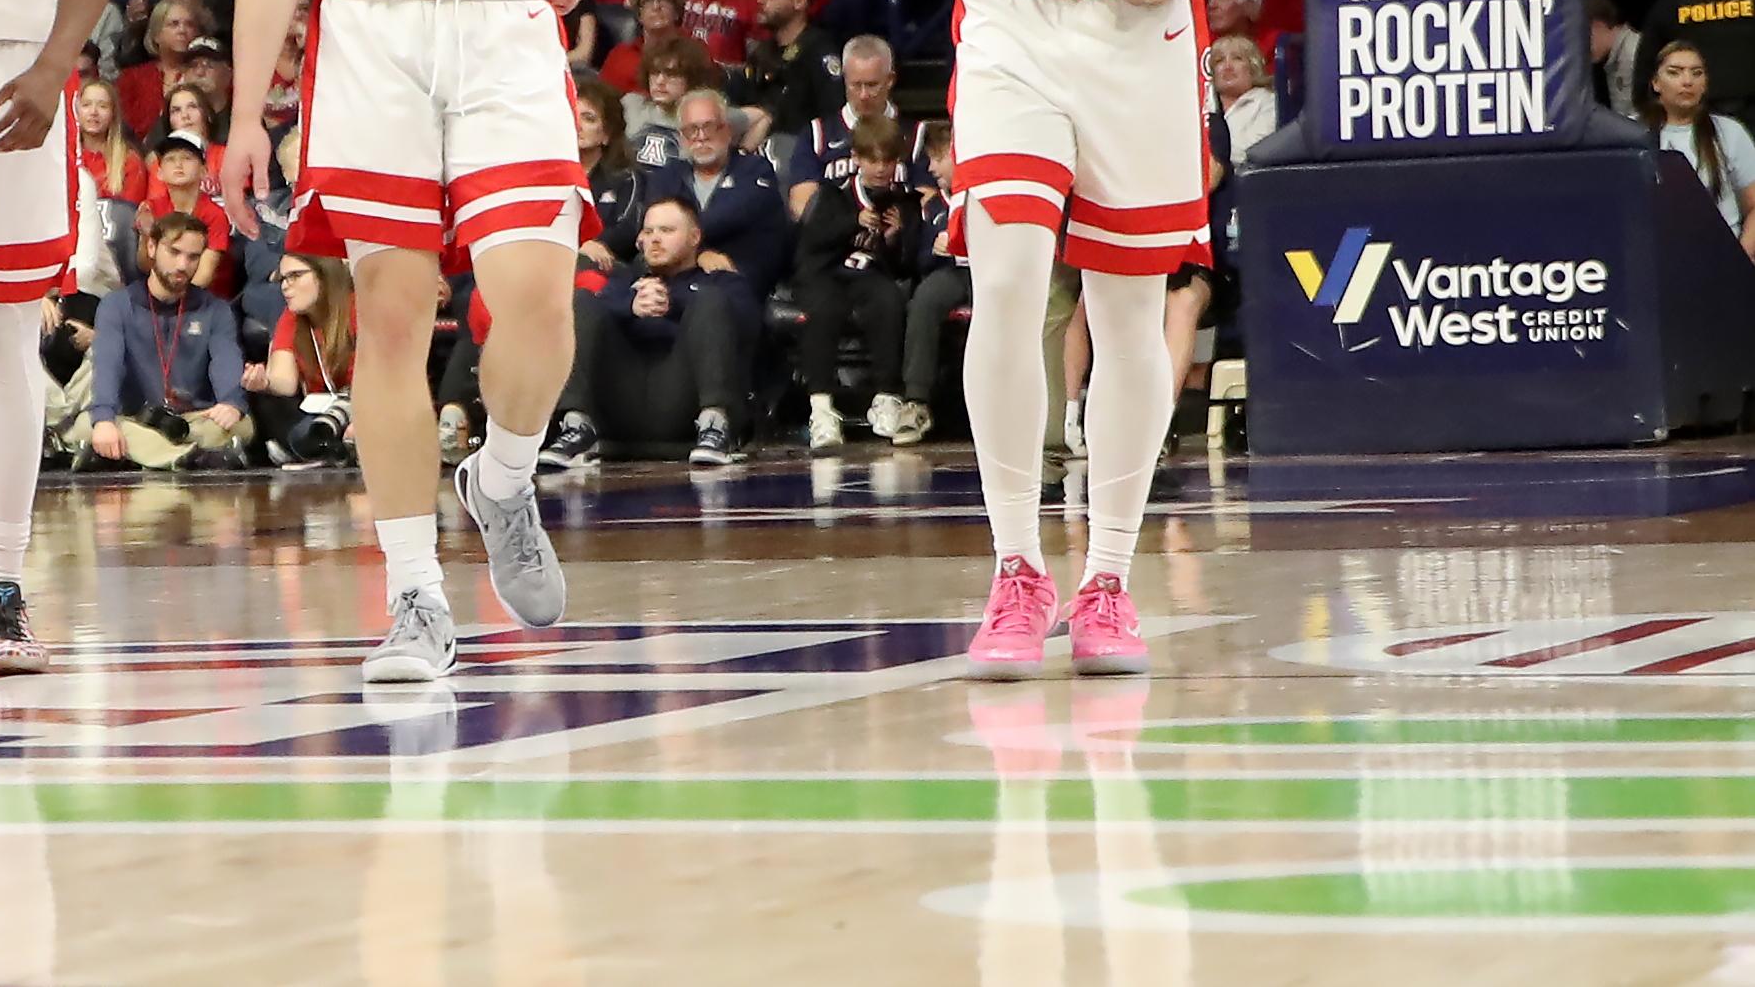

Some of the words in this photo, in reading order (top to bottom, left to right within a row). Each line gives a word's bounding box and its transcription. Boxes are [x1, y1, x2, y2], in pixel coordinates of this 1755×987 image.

[1339, 69, 1545, 141] PROTEIN
[1392, 256, 1608, 303] Vantage
[1387, 303, 1519, 347] West
[1522, 308, 1608, 326] CREDIT
[1528, 325, 1603, 343] UNION
